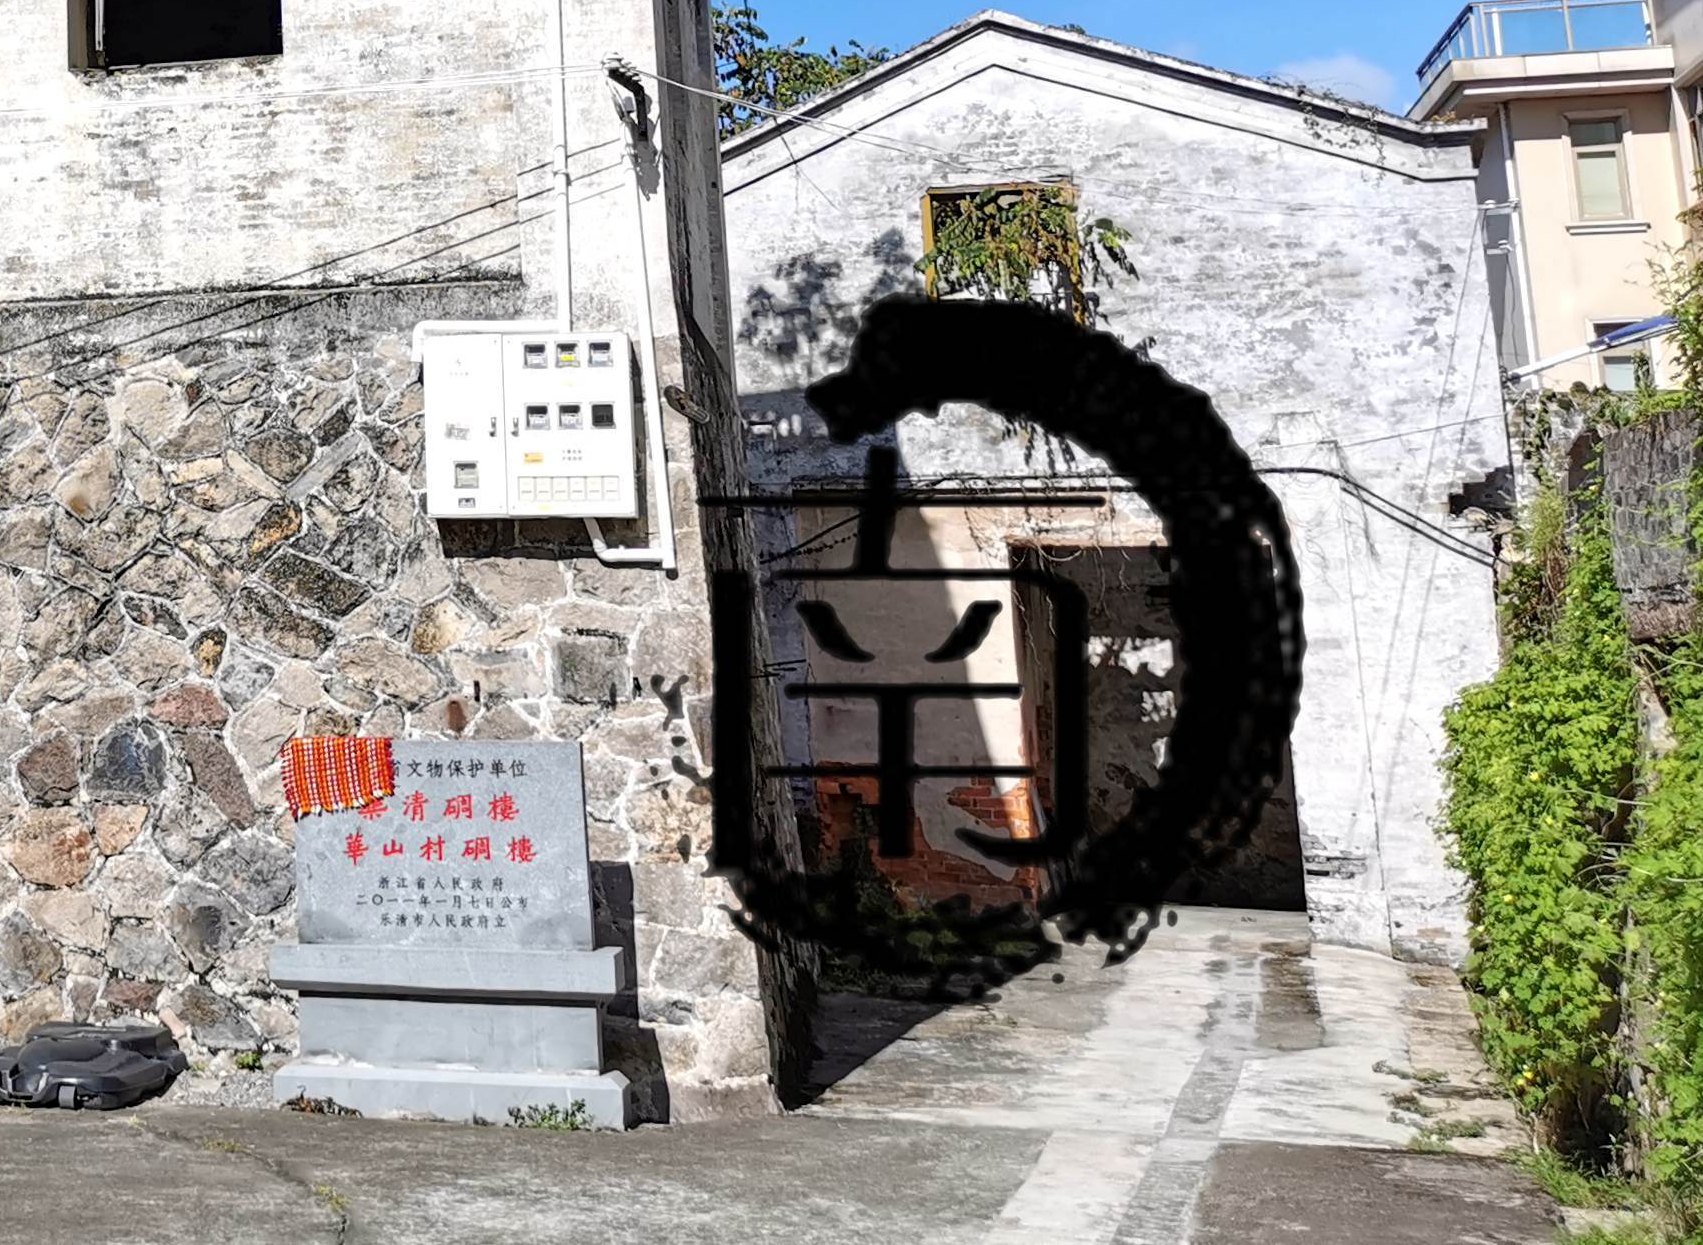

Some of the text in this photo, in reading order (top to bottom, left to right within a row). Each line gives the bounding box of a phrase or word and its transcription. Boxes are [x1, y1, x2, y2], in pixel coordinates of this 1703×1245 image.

[343, 828, 537, 866] 華山村碉樓
[378, 876, 504, 892] 浙江省人民政府
[380, 912, 507, 929] 乐清市人民政府立
